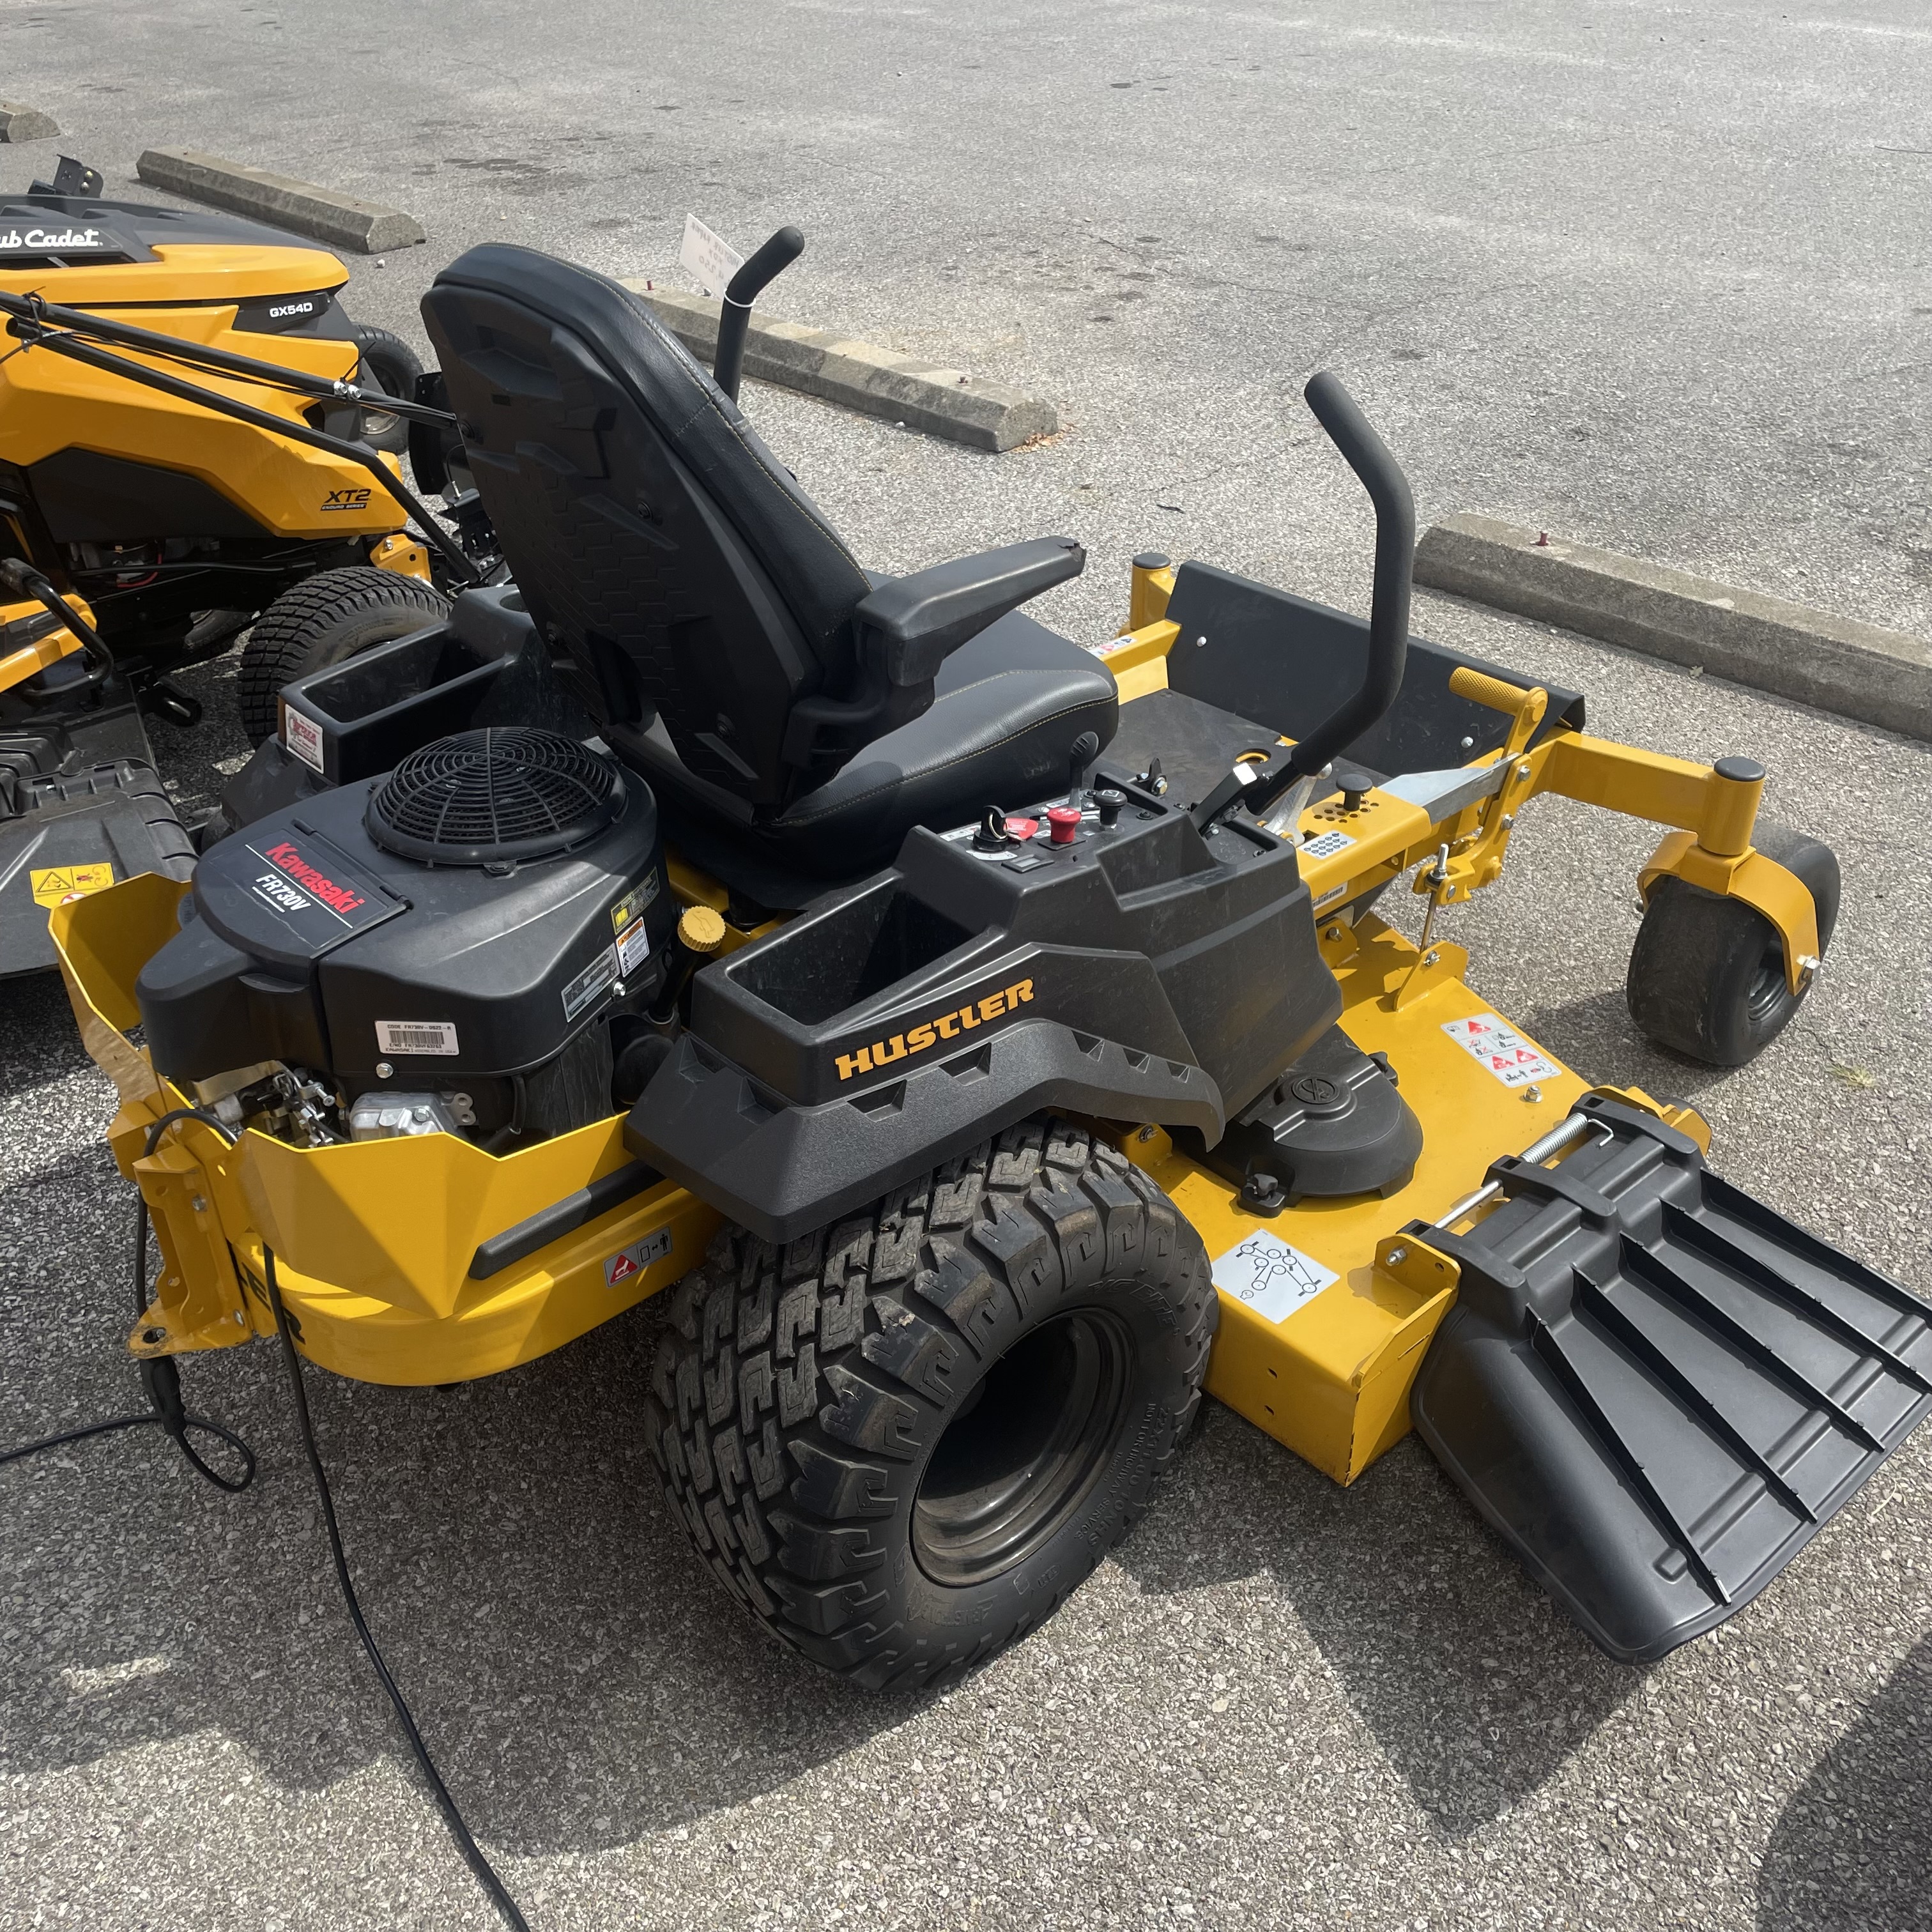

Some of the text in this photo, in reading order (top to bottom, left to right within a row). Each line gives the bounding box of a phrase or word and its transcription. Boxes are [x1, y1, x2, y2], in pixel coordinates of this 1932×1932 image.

[0, 229, 99, 248] ub Cadet
[270, 302, 313, 318] GX54D
[324, 489, 371, 503] XT2
[256, 873, 312, 910] FR730V
[264, 842, 365, 914] Kawasaki
[835, 978, 1034, 1080] HUSTLER
[1073, 1498, 1110, 1540] SERVICE
